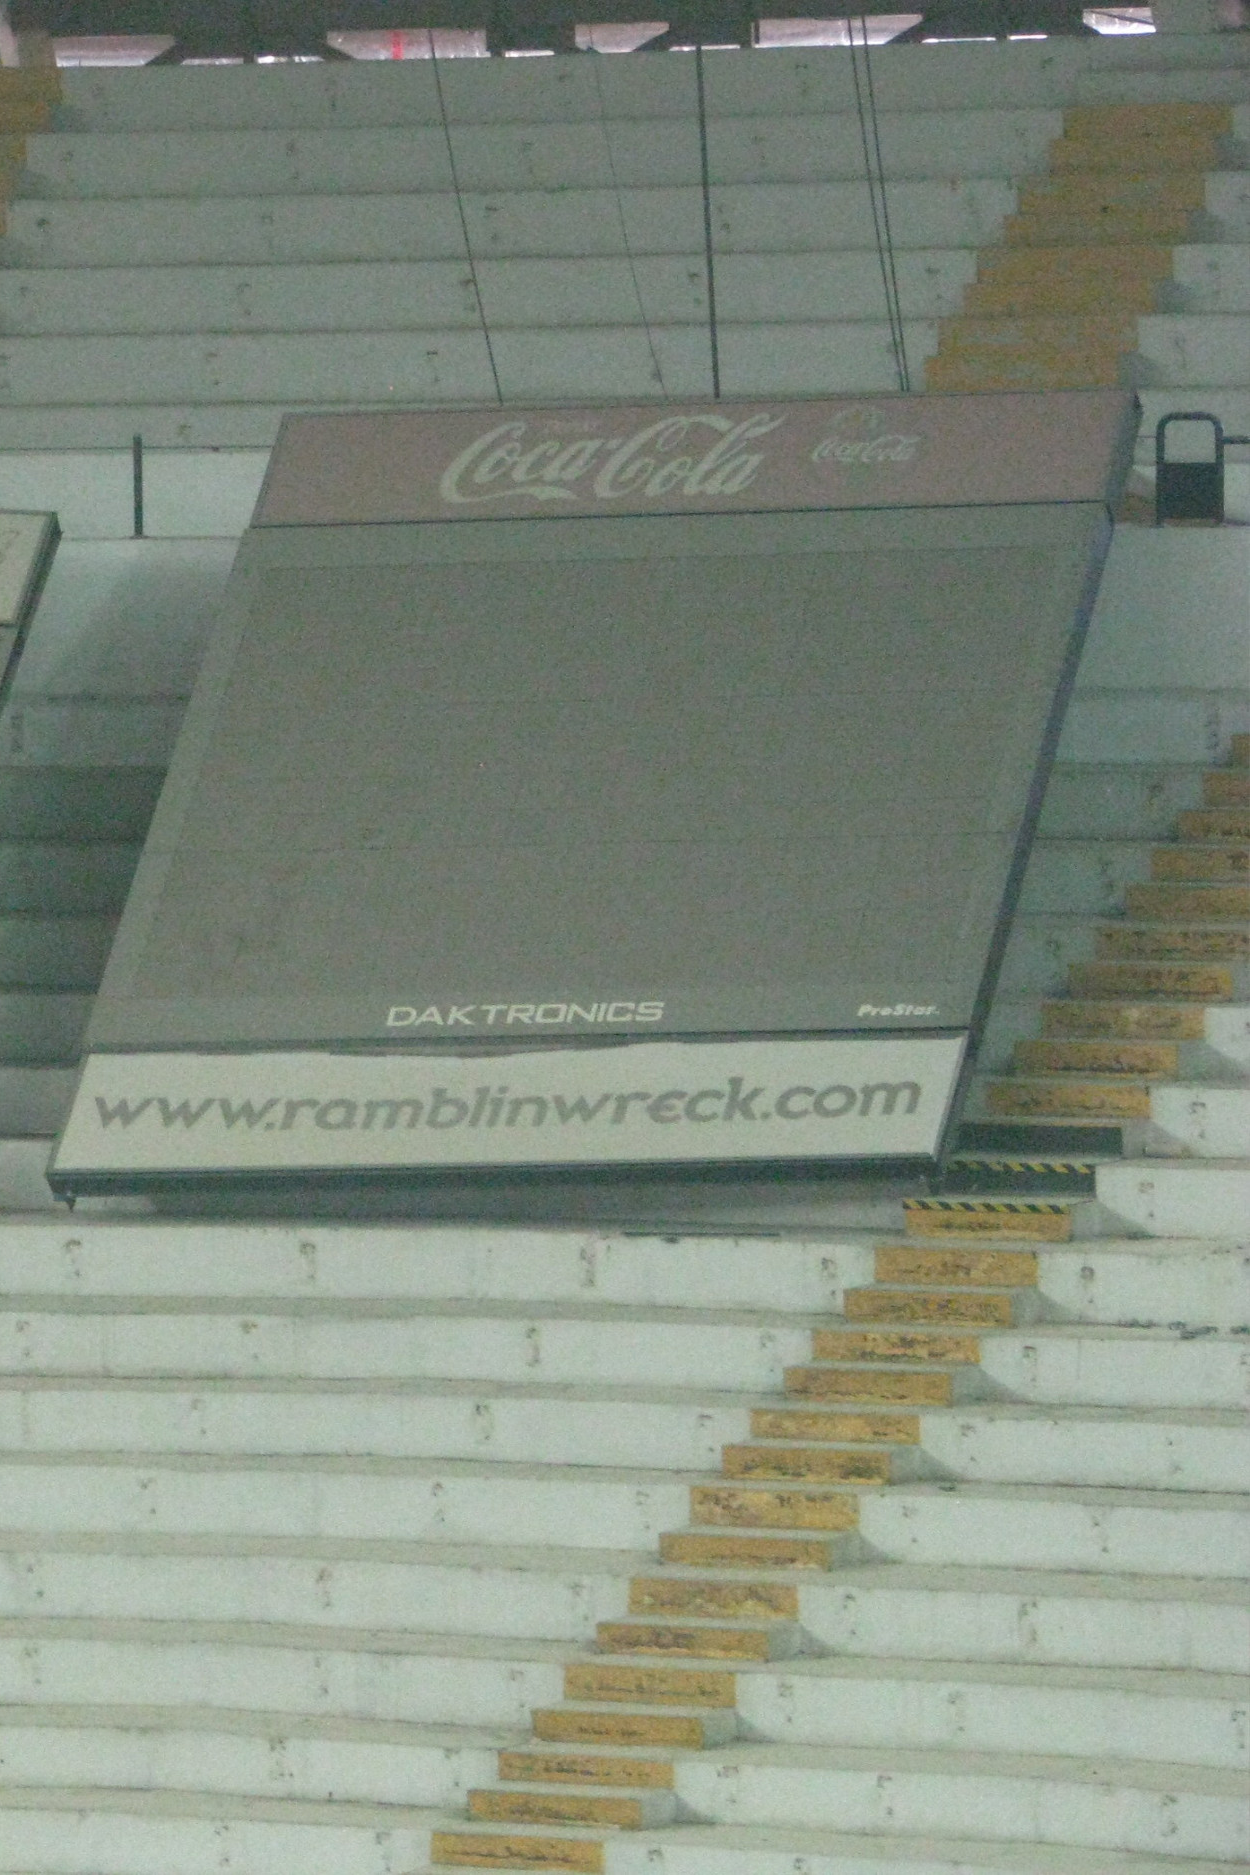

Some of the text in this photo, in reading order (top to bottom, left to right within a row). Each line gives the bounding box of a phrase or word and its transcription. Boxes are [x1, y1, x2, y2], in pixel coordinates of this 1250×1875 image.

[440, 412, 788, 503] Coca-Cola
[385, 1001, 665, 1028] DAKTRONICS
[93, 1075, 922, 1133] www.ramblinwreck.com
